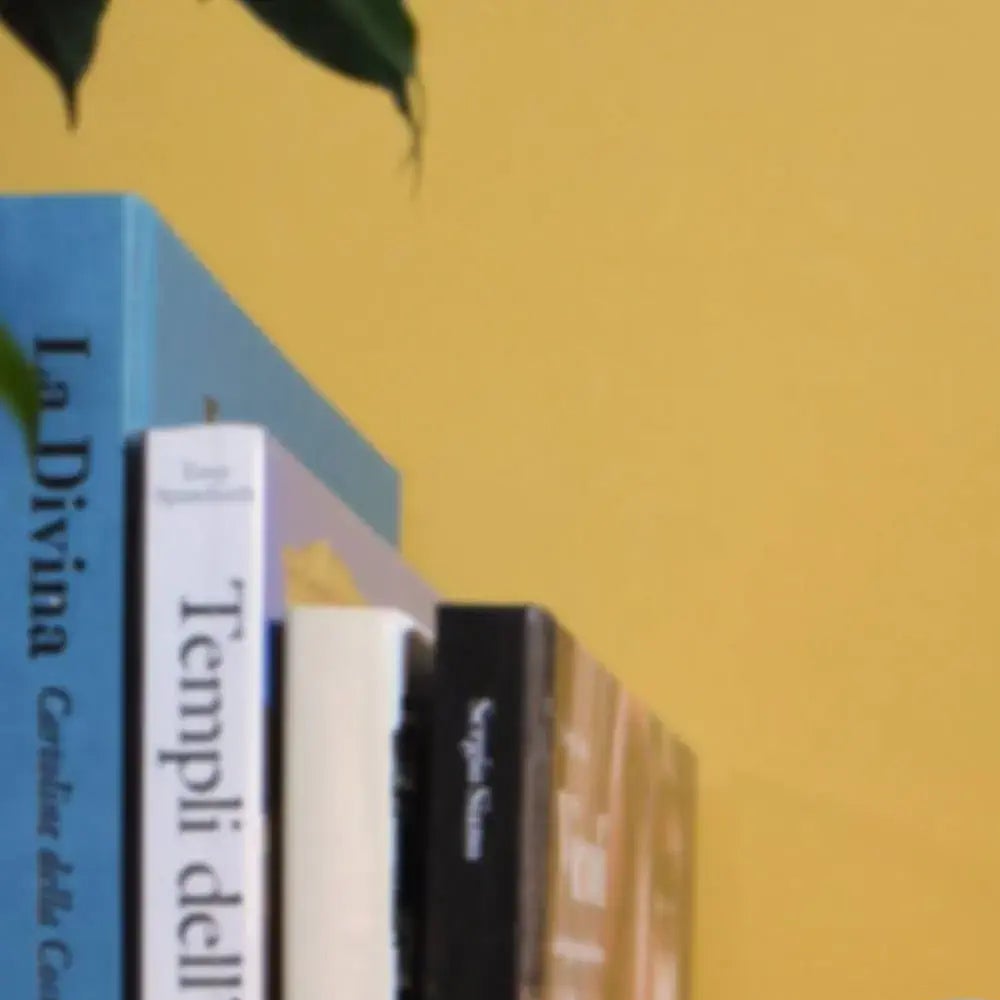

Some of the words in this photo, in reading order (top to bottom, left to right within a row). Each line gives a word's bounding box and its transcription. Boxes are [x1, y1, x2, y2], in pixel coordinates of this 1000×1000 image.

[34, 335, 92, 412] La
[28, 436, 93, 658] Divina
[156, 578, 247, 835] Templi
[37, 847, 75, 927] della
